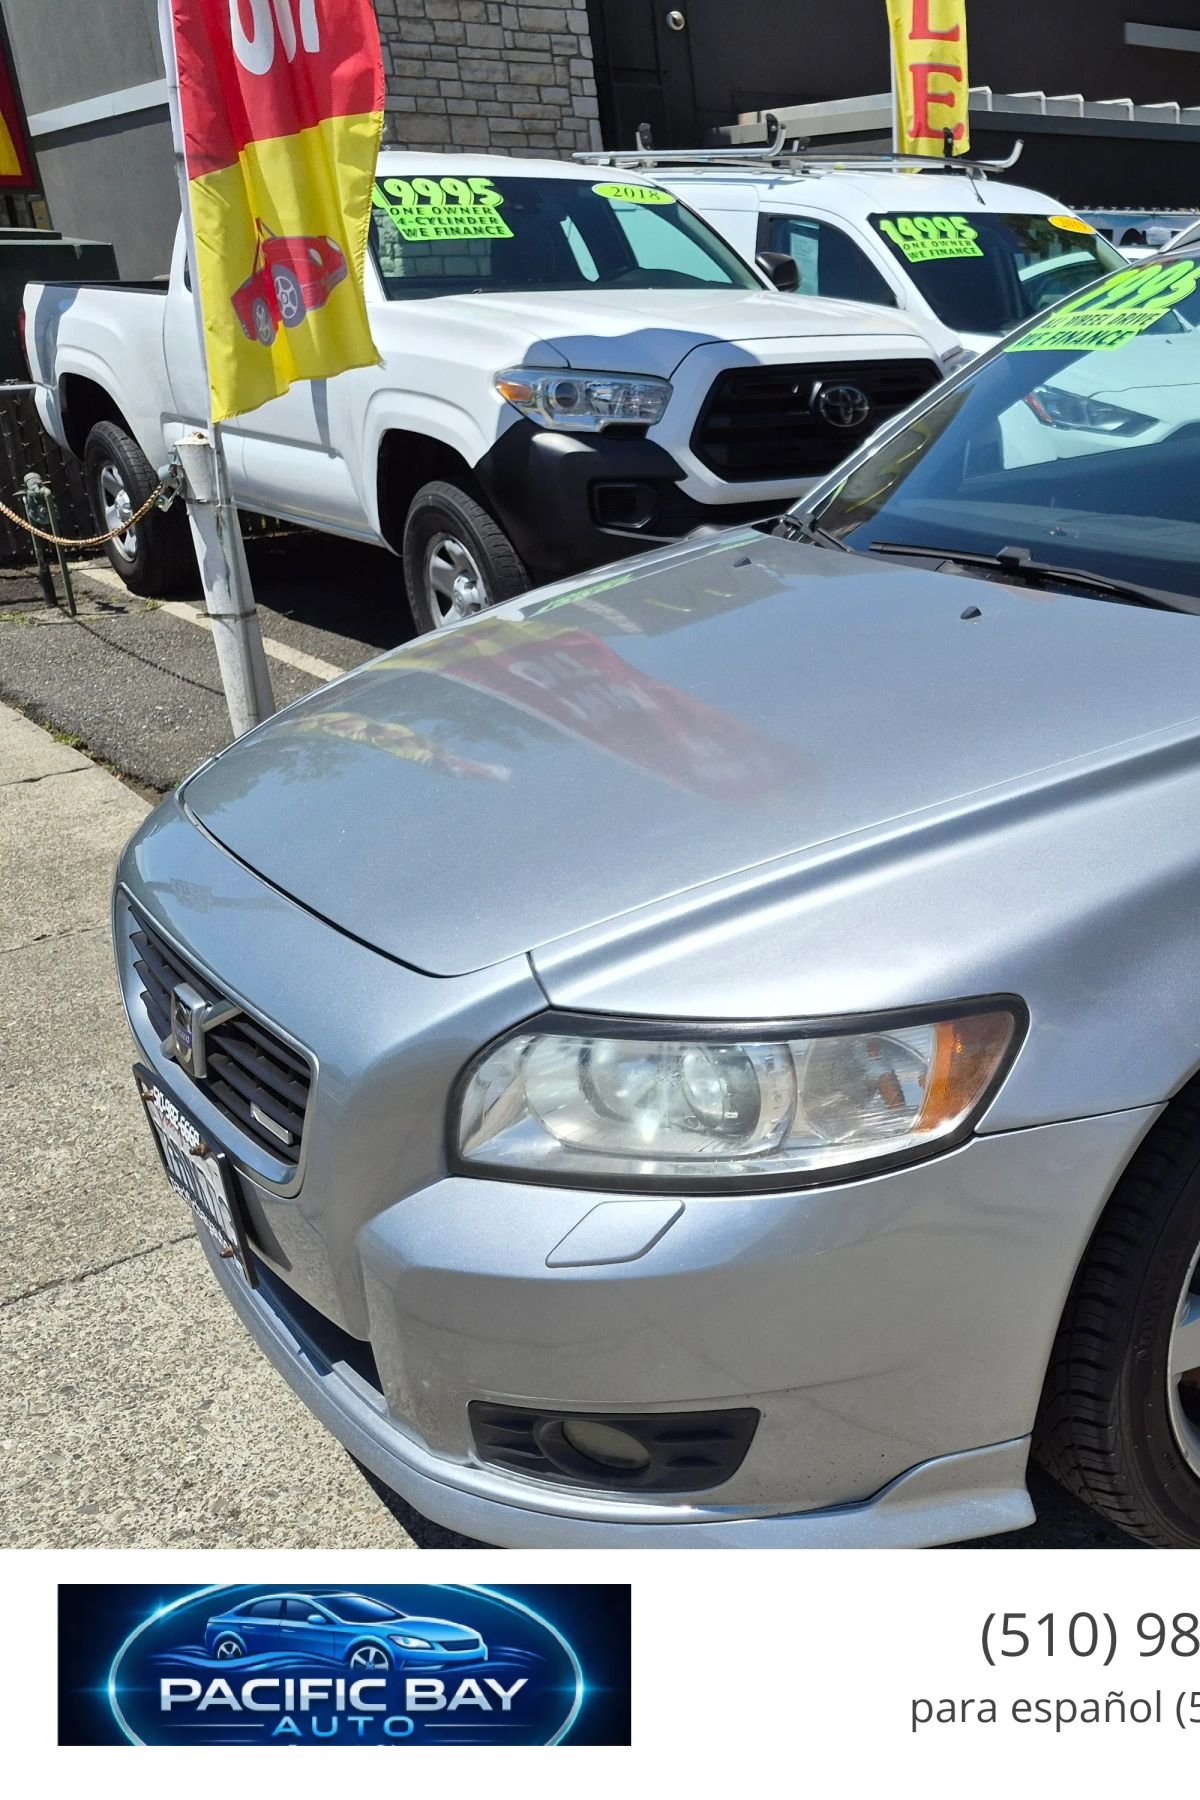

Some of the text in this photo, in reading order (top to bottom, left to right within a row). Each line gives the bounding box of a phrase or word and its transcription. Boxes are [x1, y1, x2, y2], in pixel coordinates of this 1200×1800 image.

[610, 186, 660, 201] 2018
[390, 206, 493, 216] ONE OWNER
[396, 216, 499, 226] 4-CYLINDER
[402, 226, 505, 238] WE FINANCE
[903, 239, 973, 251] ONE OWNER
[908, 247, 978, 260] WE FINANCE
[1063, 313, 1113, 327] WHEEL
[1108, 312, 1160, 326] DRIVE
[1014, 330, 1136, 348] WE FINANCE
